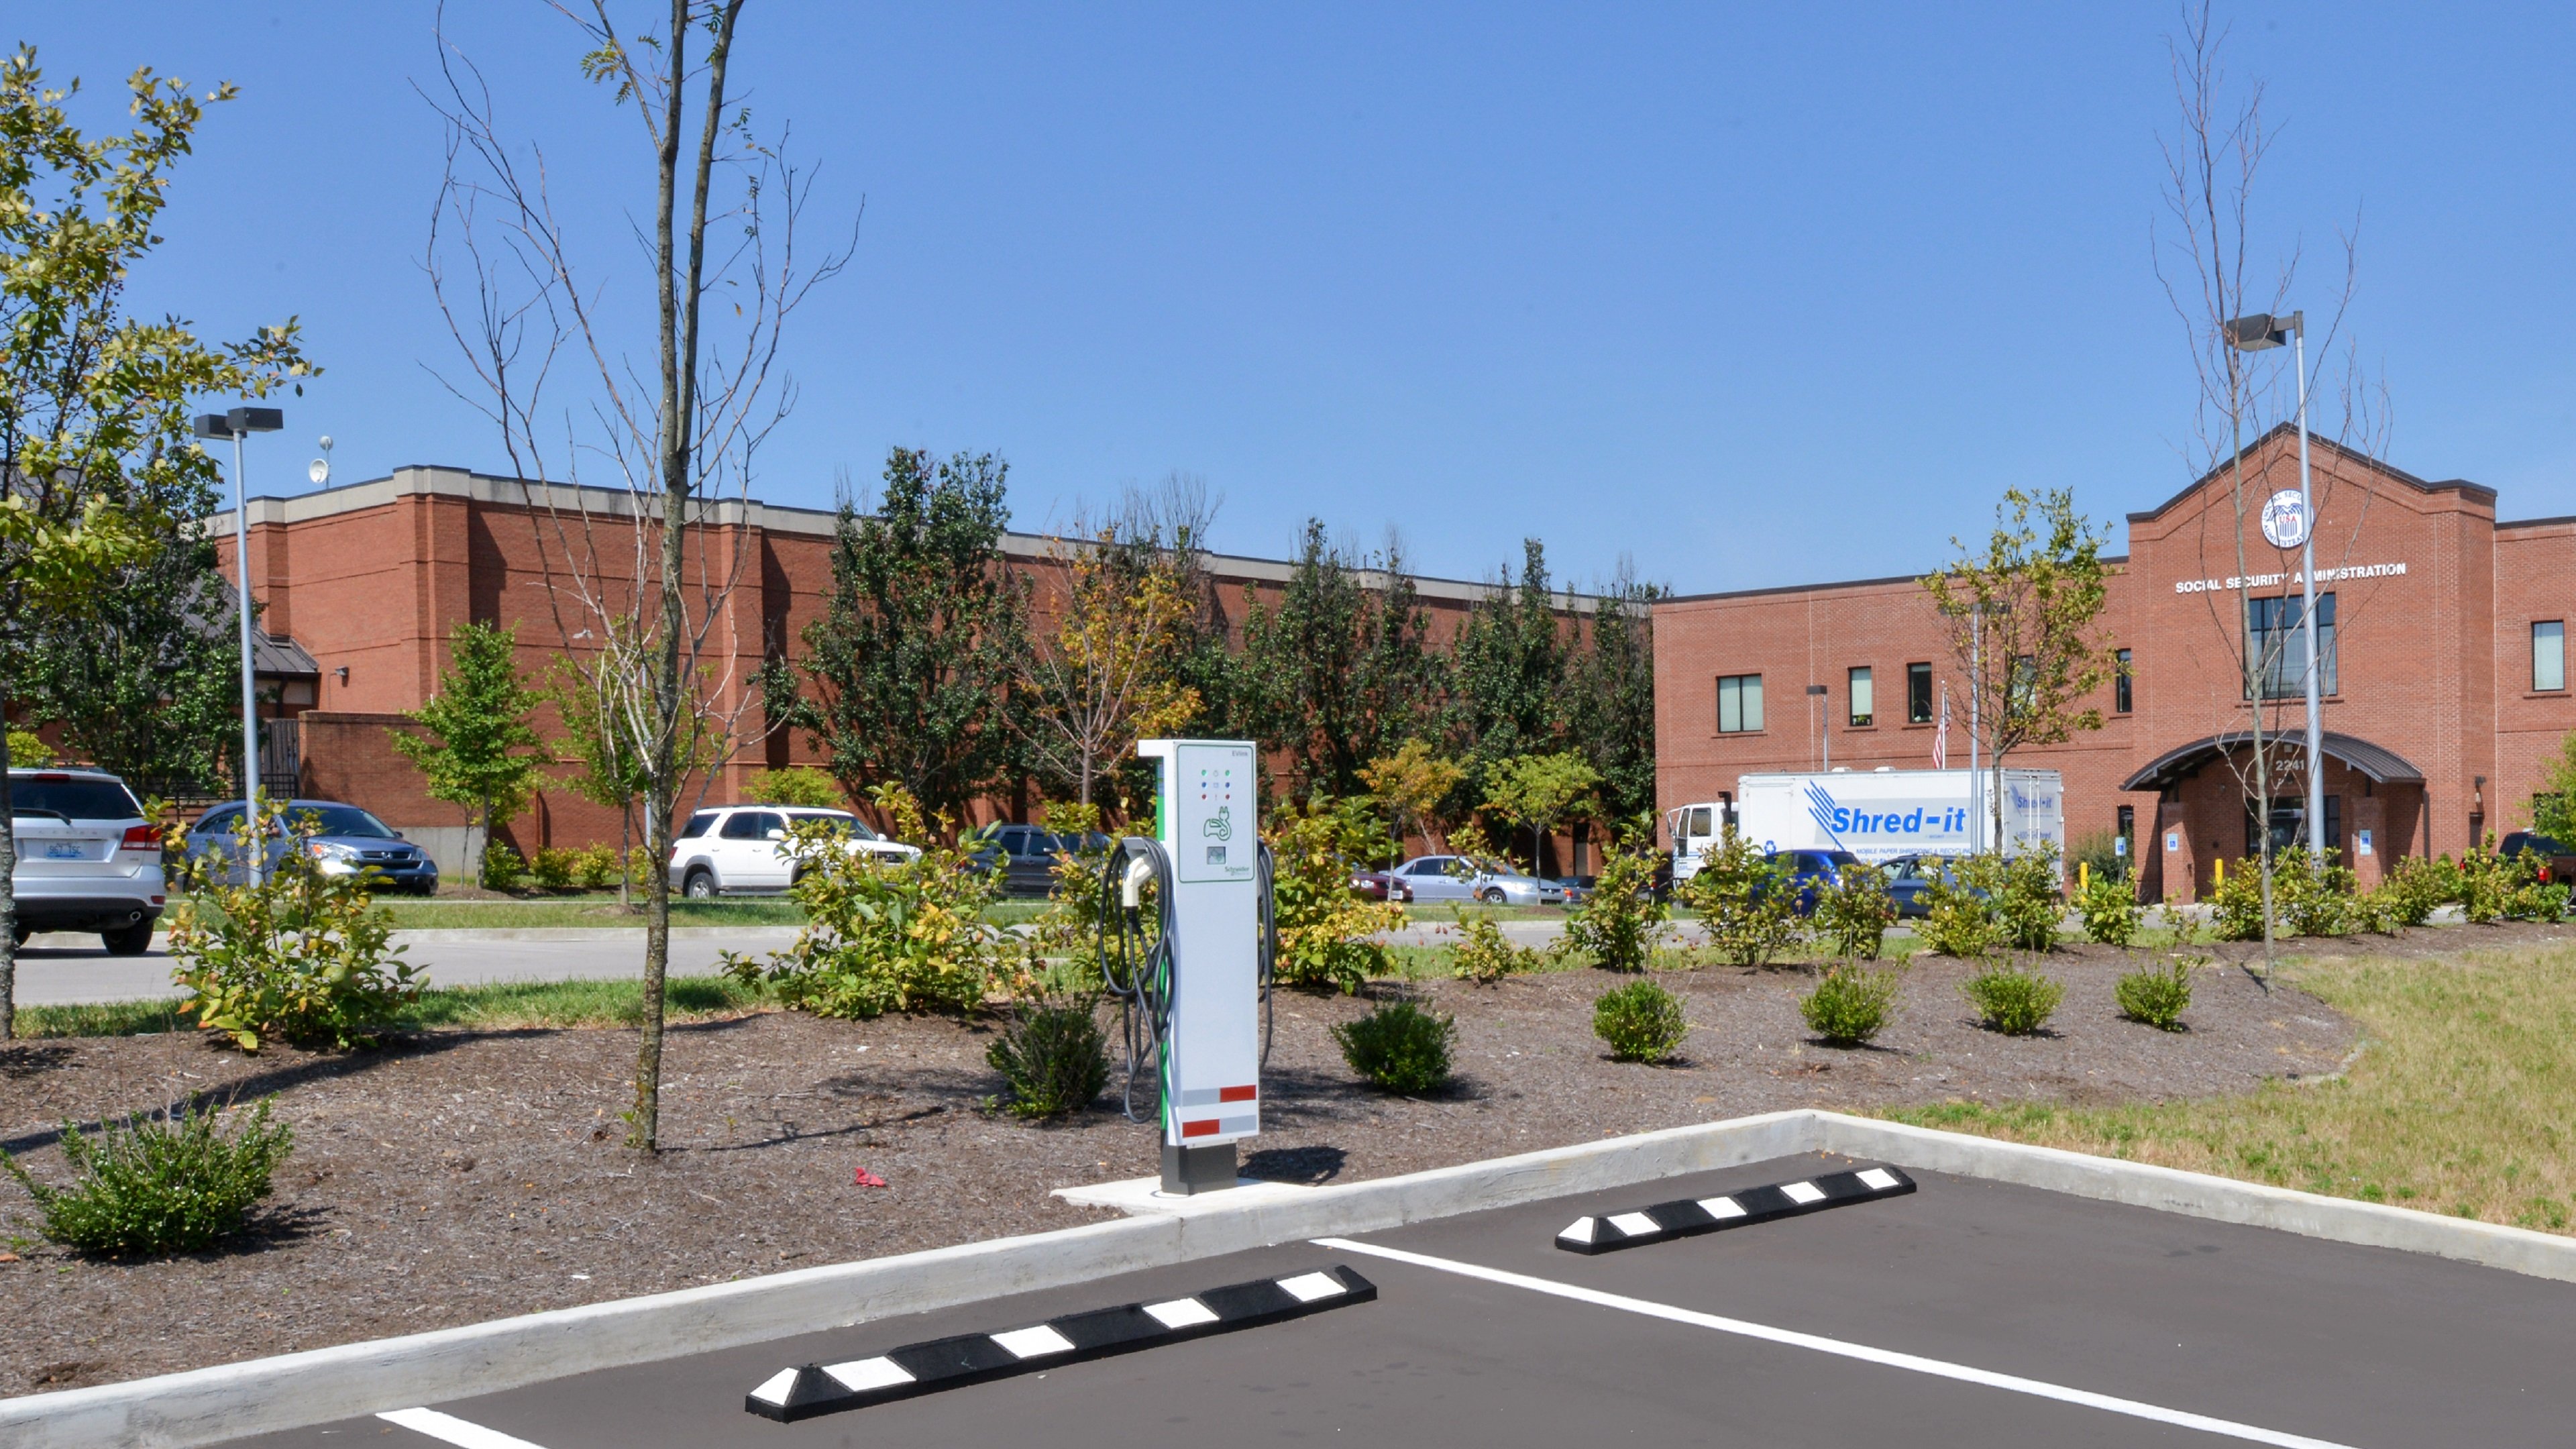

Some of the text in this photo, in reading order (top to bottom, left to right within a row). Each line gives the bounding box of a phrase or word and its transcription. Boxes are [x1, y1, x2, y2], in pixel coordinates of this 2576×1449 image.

[2279, 515, 2296, 523] USA
[2176, 563, 2406, 594] SOCIAL SECURITY AMINISTRATION
[2275, 759, 2304, 771] 2241
[1831, 806, 1966, 833] Shred-it
